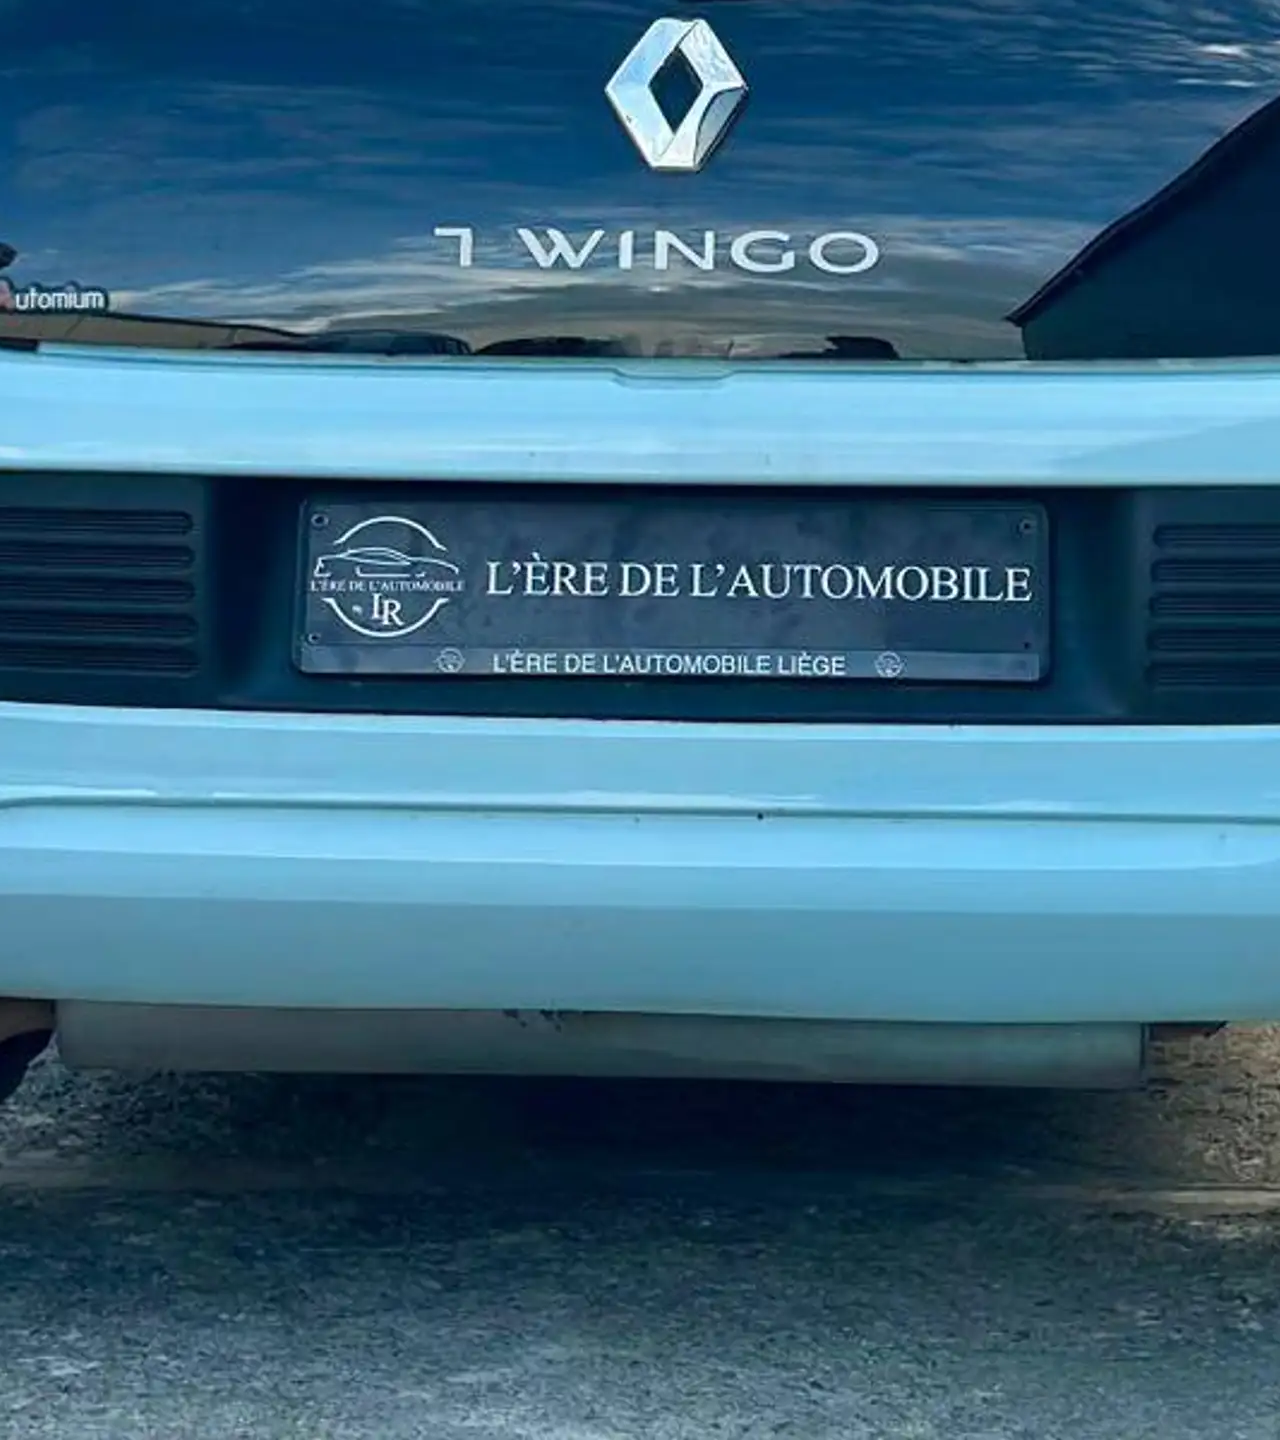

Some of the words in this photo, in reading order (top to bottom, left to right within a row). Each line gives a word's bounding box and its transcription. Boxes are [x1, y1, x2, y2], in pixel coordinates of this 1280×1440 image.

[486, 551, 610, 596] L'ÈRE
[619, 562, 680, 598] DE
[688, 563, 1033, 603] L'AUTOMOBILE
[493, 649, 558, 673] L'ÈRE
[564, 653, 596, 674] DE
[602, 654, 771, 675] L'AUTOMOBILE
[777, 651, 846, 676] LIÈGE
